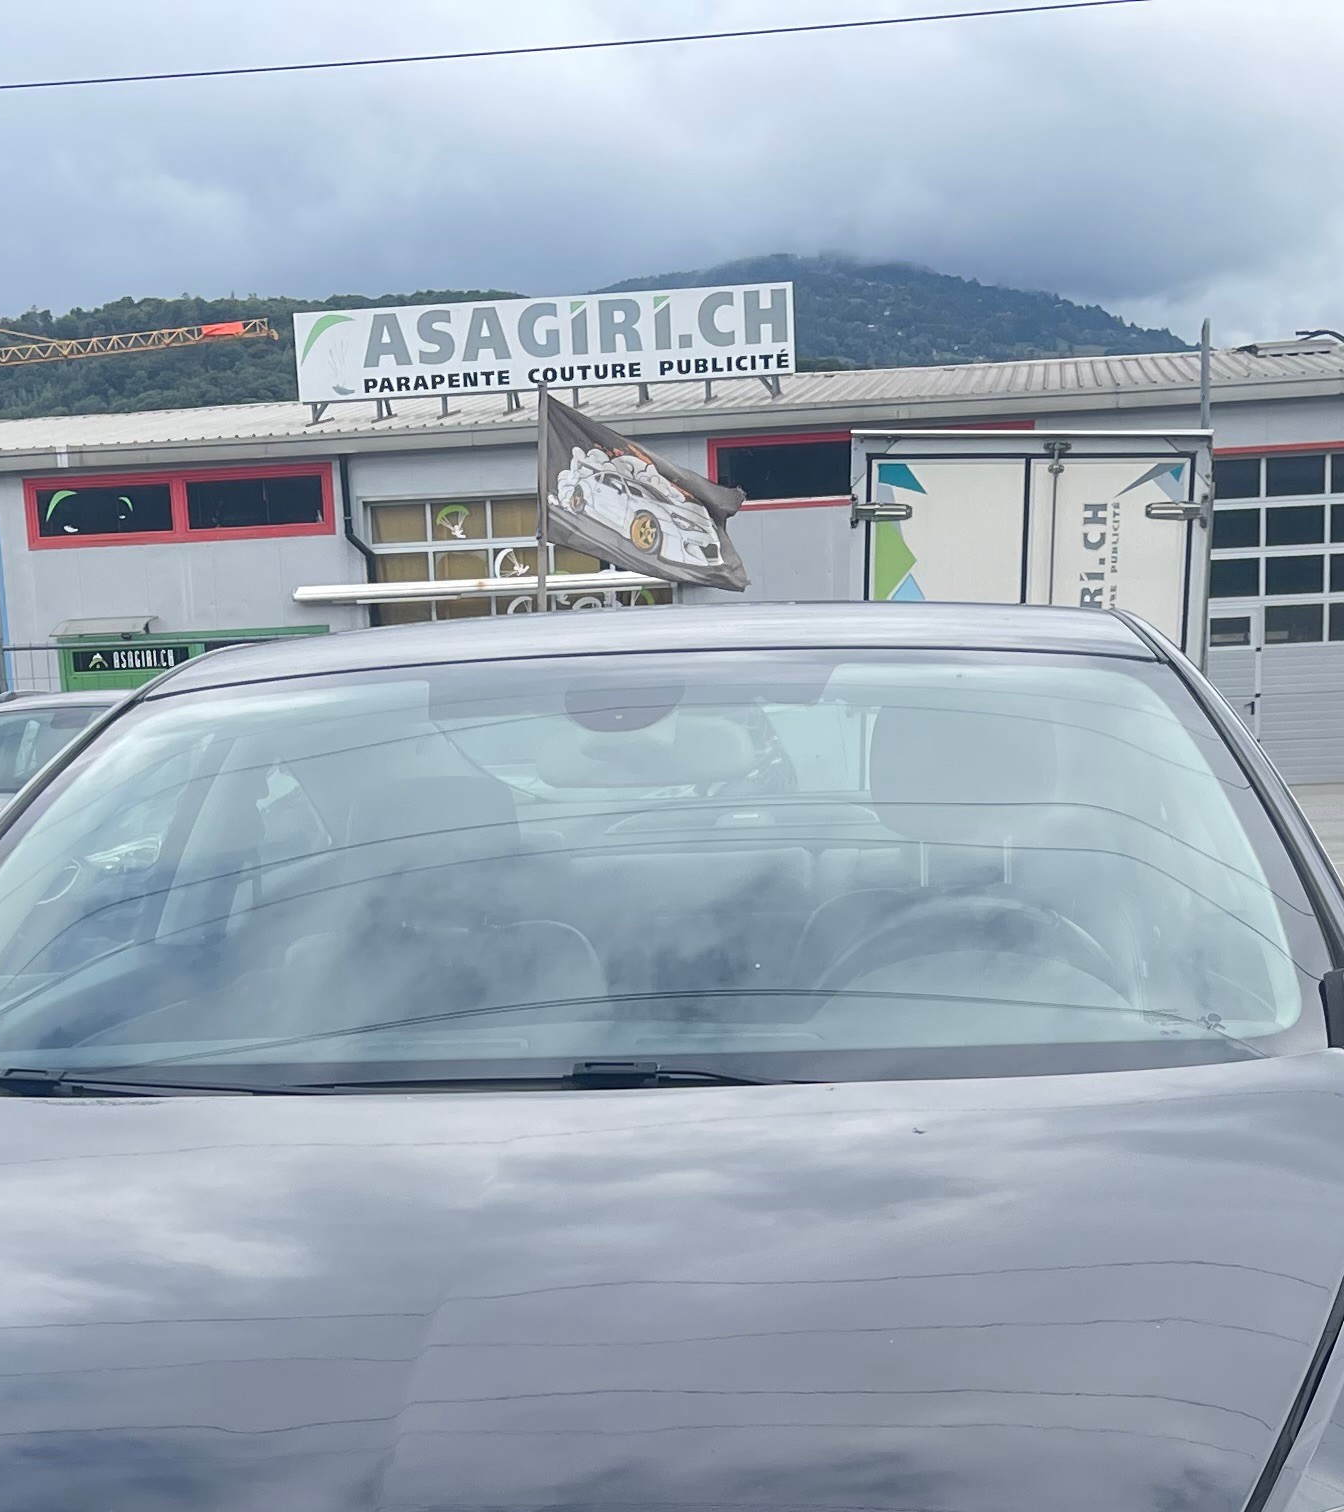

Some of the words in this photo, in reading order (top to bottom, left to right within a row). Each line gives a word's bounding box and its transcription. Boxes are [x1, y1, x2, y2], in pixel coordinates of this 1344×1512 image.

[364, 371, 510, 394] PARAPENTE
[528, 361, 642, 383] COUTURE
[659, 349, 790, 377] PUBLICITÉ
[113, 649, 174, 669] ASAGIRI.CH
